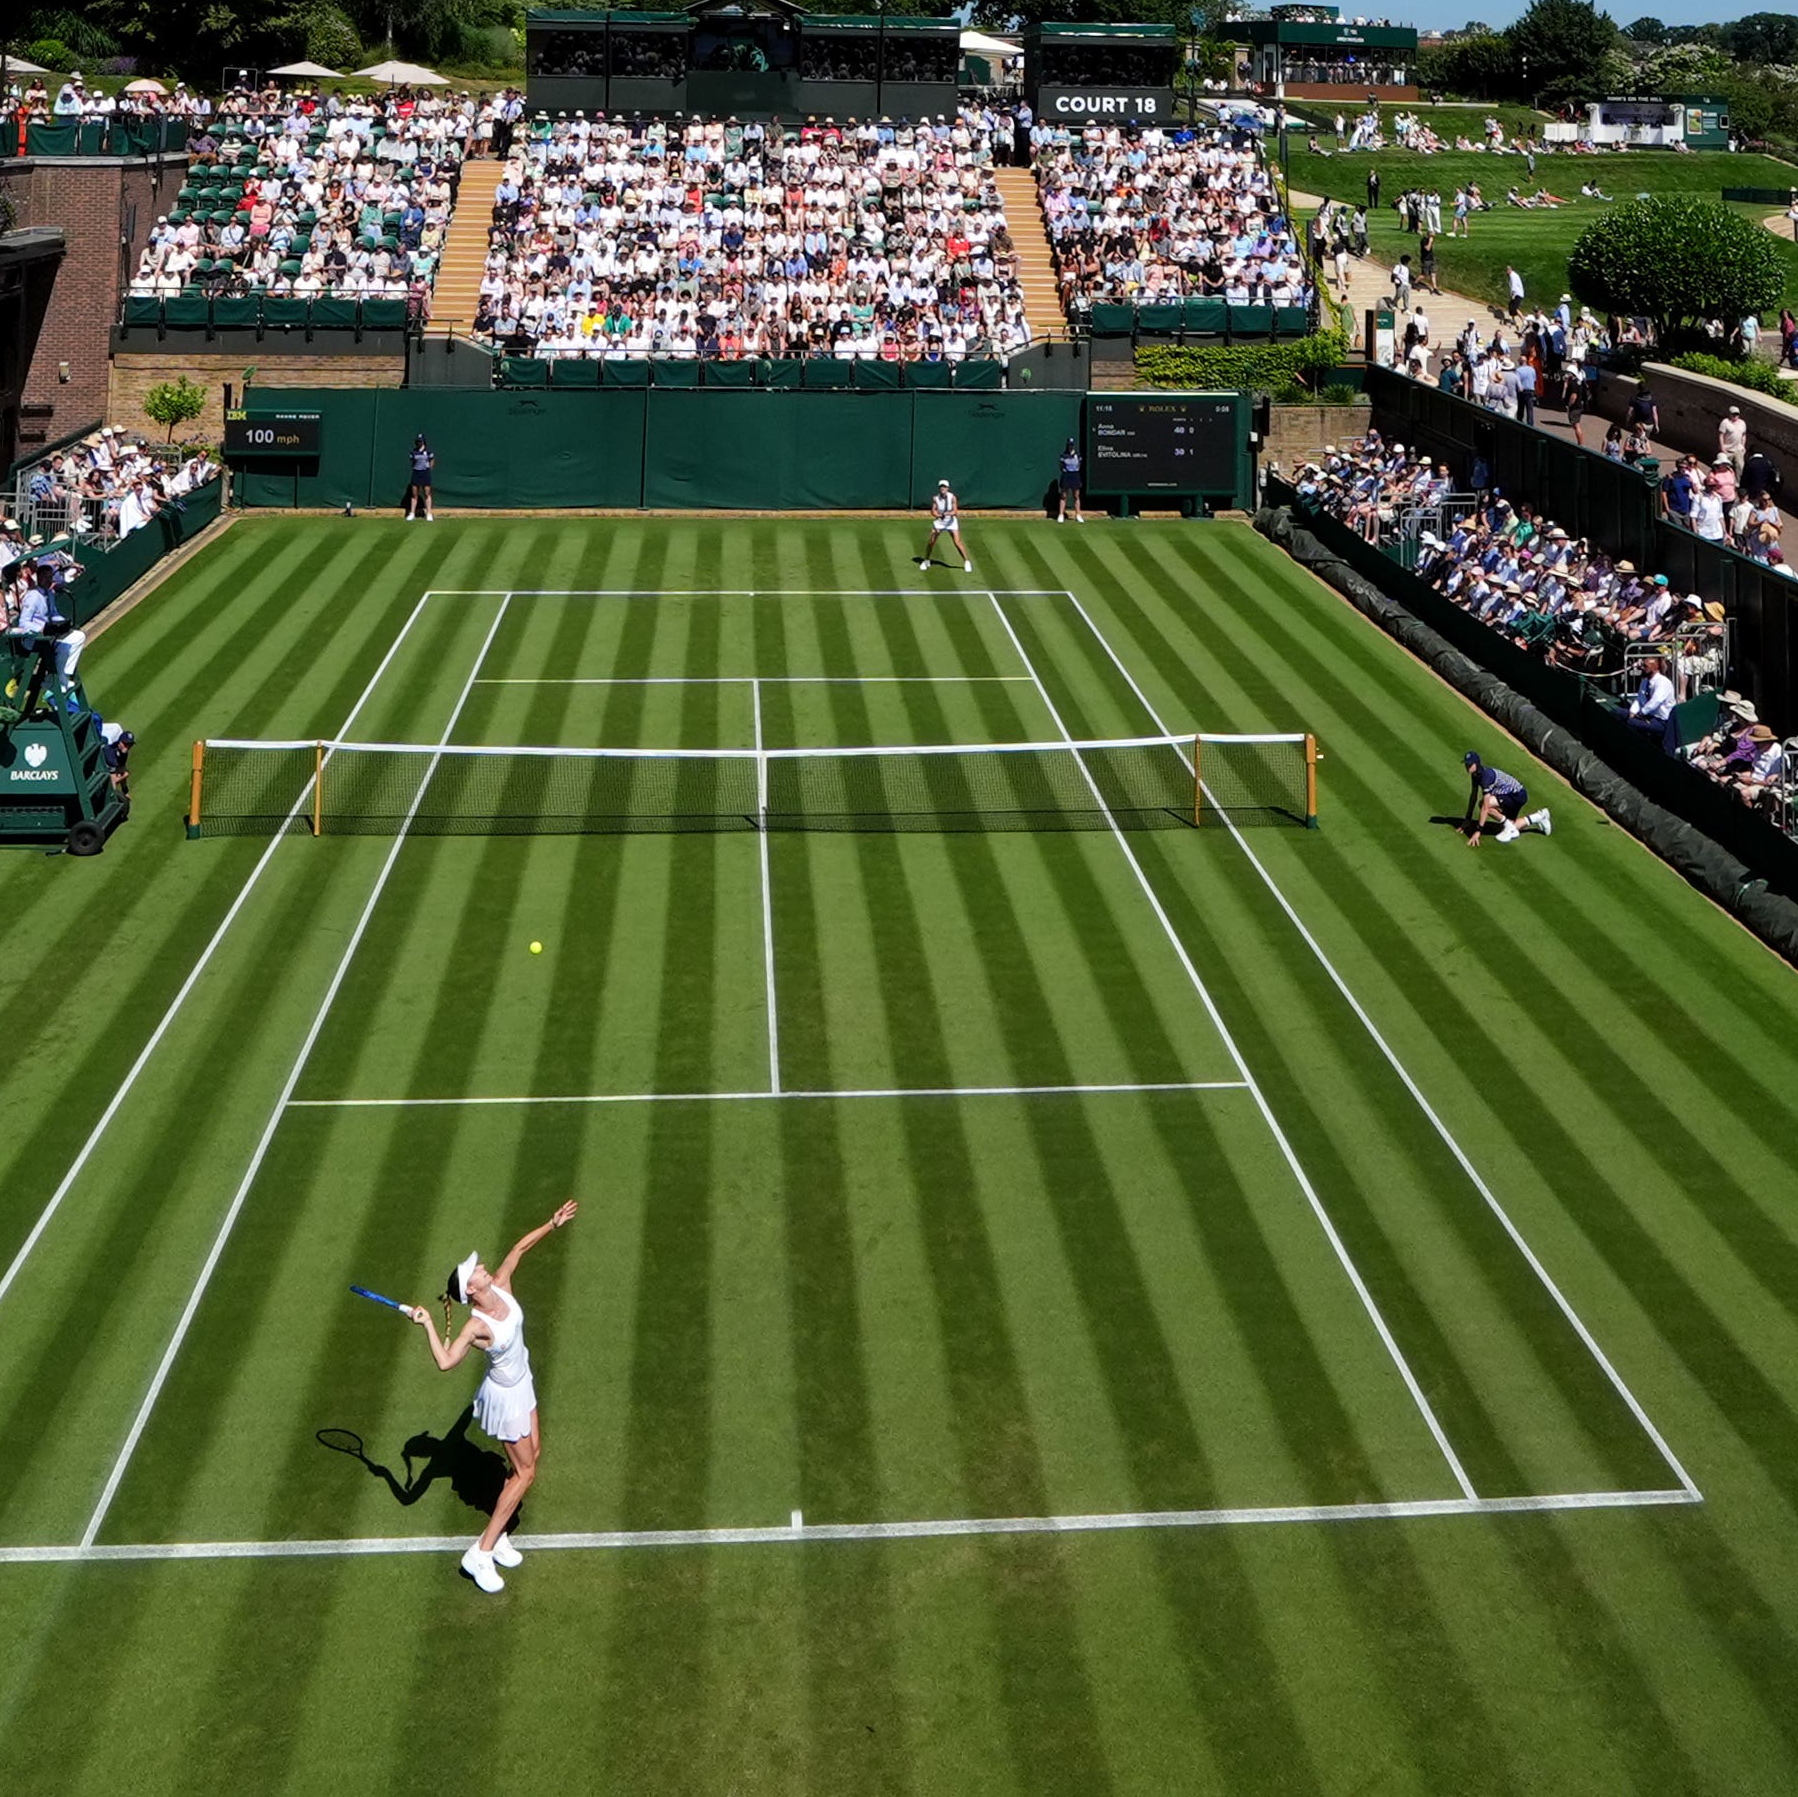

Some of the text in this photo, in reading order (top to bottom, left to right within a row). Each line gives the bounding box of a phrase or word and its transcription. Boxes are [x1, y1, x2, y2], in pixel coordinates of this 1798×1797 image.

[1055, 96, 1157, 113] COURT 18
[227, 411, 247, 420] IBM
[245, 429, 300, 445] 100 mph
[1174, 448, 1185, 456] 30
[10, 770, 59, 780] BARCLAYS
